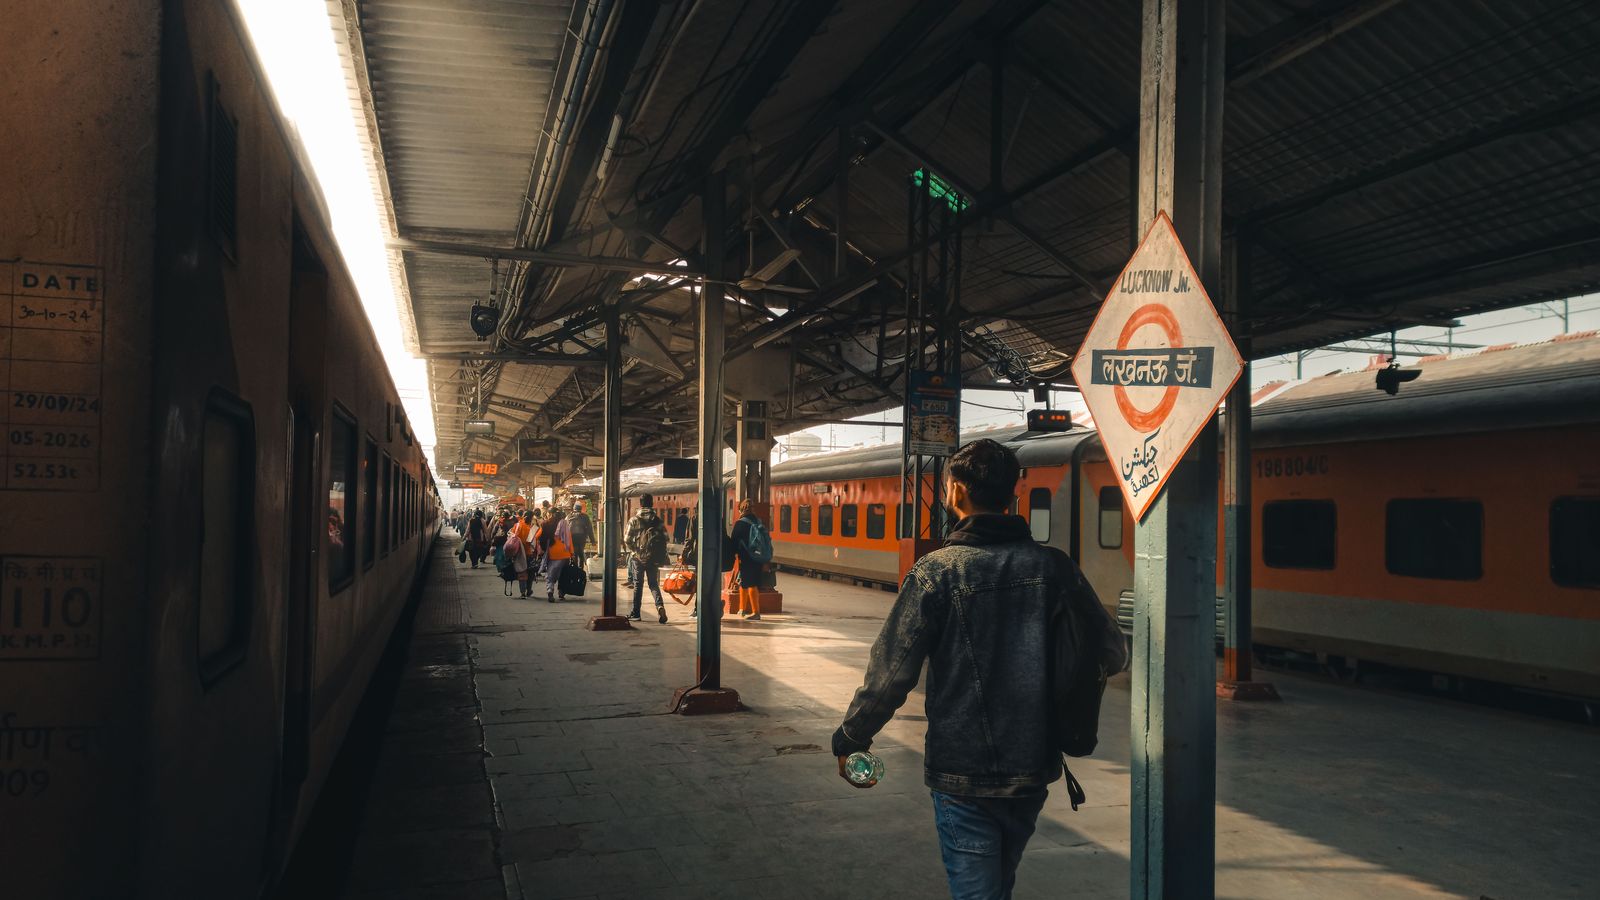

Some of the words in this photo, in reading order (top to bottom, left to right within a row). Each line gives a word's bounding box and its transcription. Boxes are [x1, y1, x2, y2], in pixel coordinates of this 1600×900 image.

[22, 272, 99, 293] DATE
[1120, 269, 1173, 295] LUCKNOW
[18, 305, 92, 324] 30-10-24
[1102, 354, 1169, 386] लखनऊ
[1175, 349, 1198, 384] जं.
[10, 430, 91, 449] 05-2026
[13, 464, 79, 481] 52.53t
[473, 463, 498, 475] 14:03
[13, 587, 92, 629] 110
[0, 768, 50, 799] 09
